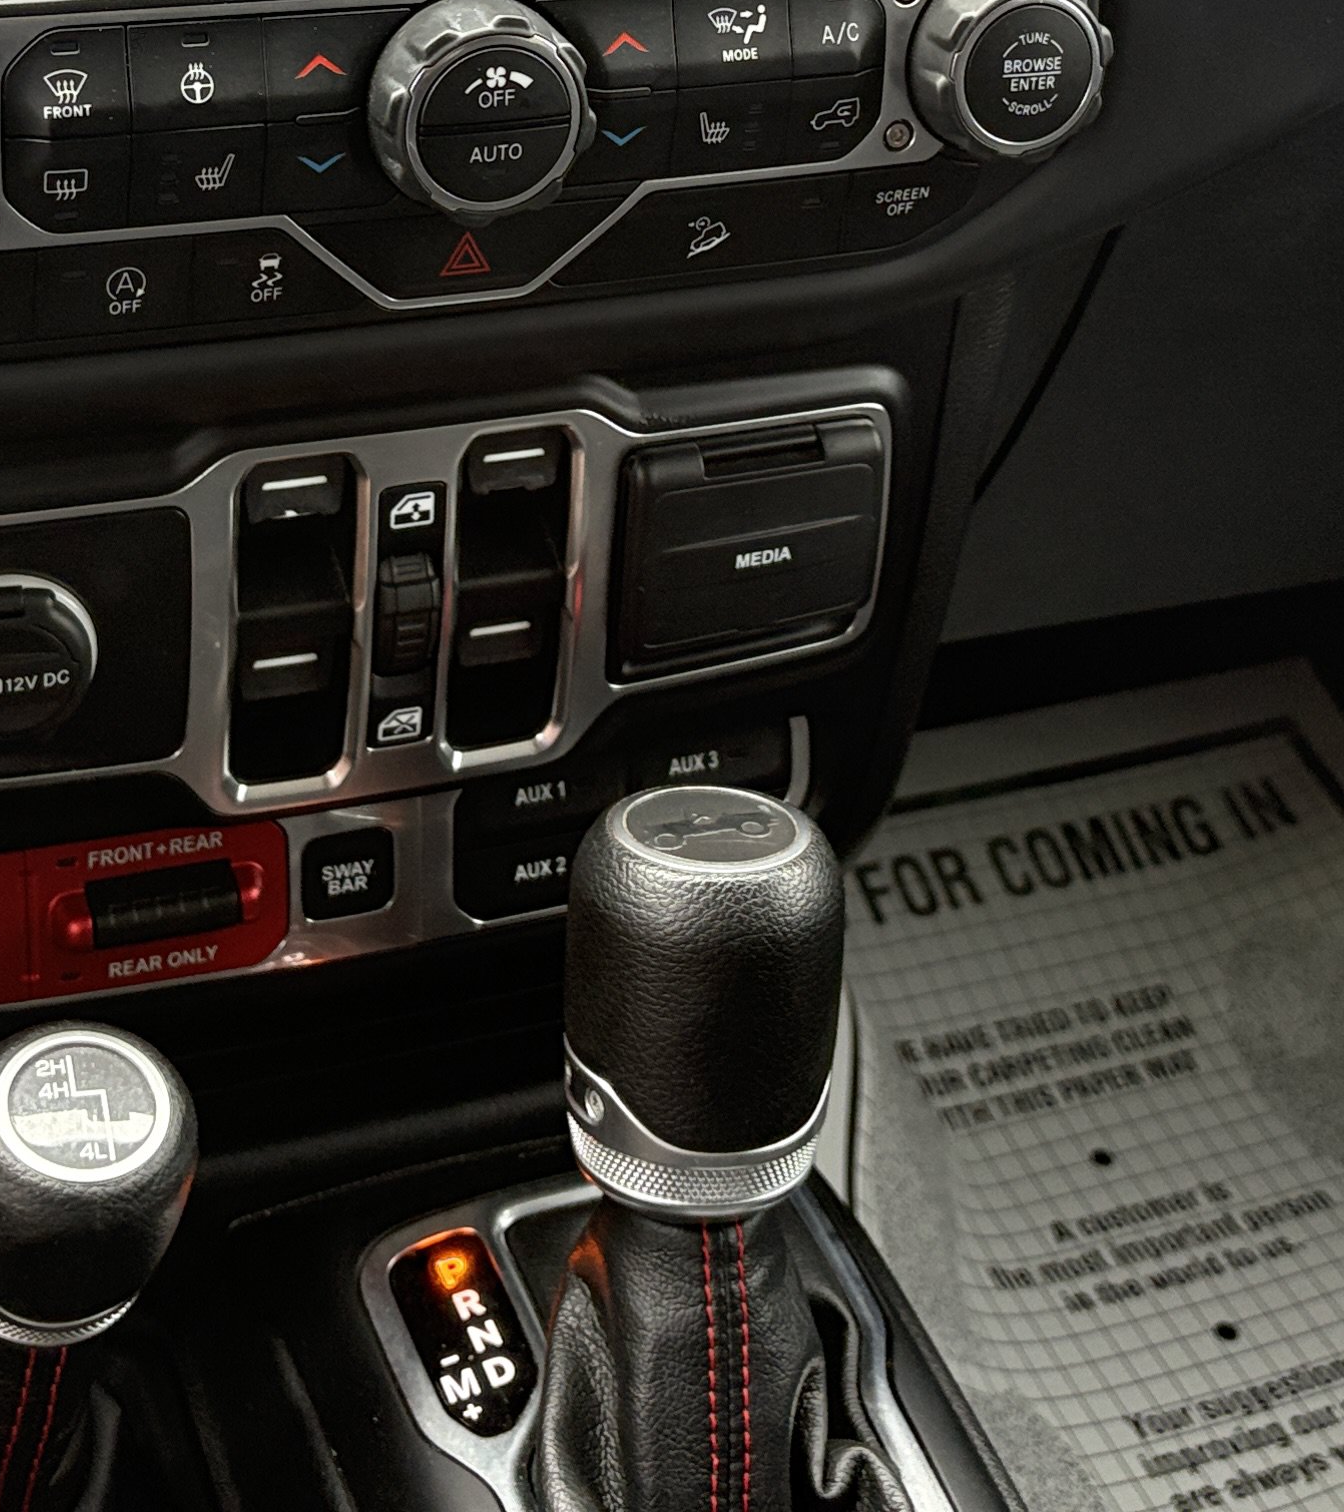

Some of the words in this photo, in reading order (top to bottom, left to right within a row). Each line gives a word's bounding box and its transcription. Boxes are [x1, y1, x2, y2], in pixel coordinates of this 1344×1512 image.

[821, 20, 860, 45] A/C
[1019, 32, 1051, 45] TUNE
[721, 46, 760, 63] MODE
[1003, 56, 1062, 74] BROWSE
[1010, 76, 1056, 92] ENTER
[478, 88, 516, 110] OFF
[1008, 100, 1053, 116] SCROLL
[42, 104, 93, 120] FRONT
[469, 141, 524, 165] AUTO
[875, 186, 930, 205] SCREEN
[886, 199, 915, 217] OFF
[108, 298, 143, 315] OFF
[250, 287, 284, 304] OFF
[735, 546, 792, 570] MEDIA
[5, 675, 39, 693] 12V
[43, 669, 71, 688] DC
[669, 753, 703, 776] AUX
[707, 750, 720, 770] 3
[515, 784, 551, 806] AUX
[557, 780, 567, 798] 1
[855, 845, 986, 926] FOR
[985, 793, 1223, 898] COMING
[1223, 776, 1301, 842] IN
[321, 859, 375, 884] SWAY
[514, 859, 551, 883] AUX
[556, 855, 568, 874] 2
[327, 874, 369, 896] BAR
[108, 954, 163, 979] REAR
[167, 944, 219, 972] ONLY
[34, 1058, 67, 1078] 2H
[38, 1080, 70, 1101] 4H
[79, 1142, 108, 1161] 4L
[1051, 1219, 1076, 1244] A
[1075, 1189, 1200, 1236] customer
[987, 1263, 1036, 1291] the
[1038, 1246, 1108, 1285] most
[1108, 1210, 1246, 1269] important
[1242, 1187, 1335, 1234] person
[434, 1257, 466, 1290] P
[451, 1288, 487, 1322] R
[466, 1319, 504, 1354] N
[482, 1356, 516, 1388] D
[439, 1367, 481, 1404] M
[1121, 1405, 1194, 1439] Your
[1137, 1421, 1292, 1478] improving
[1289, 1405, 1340, 1436] our
[1224, 1451, 1331, 1501] always
